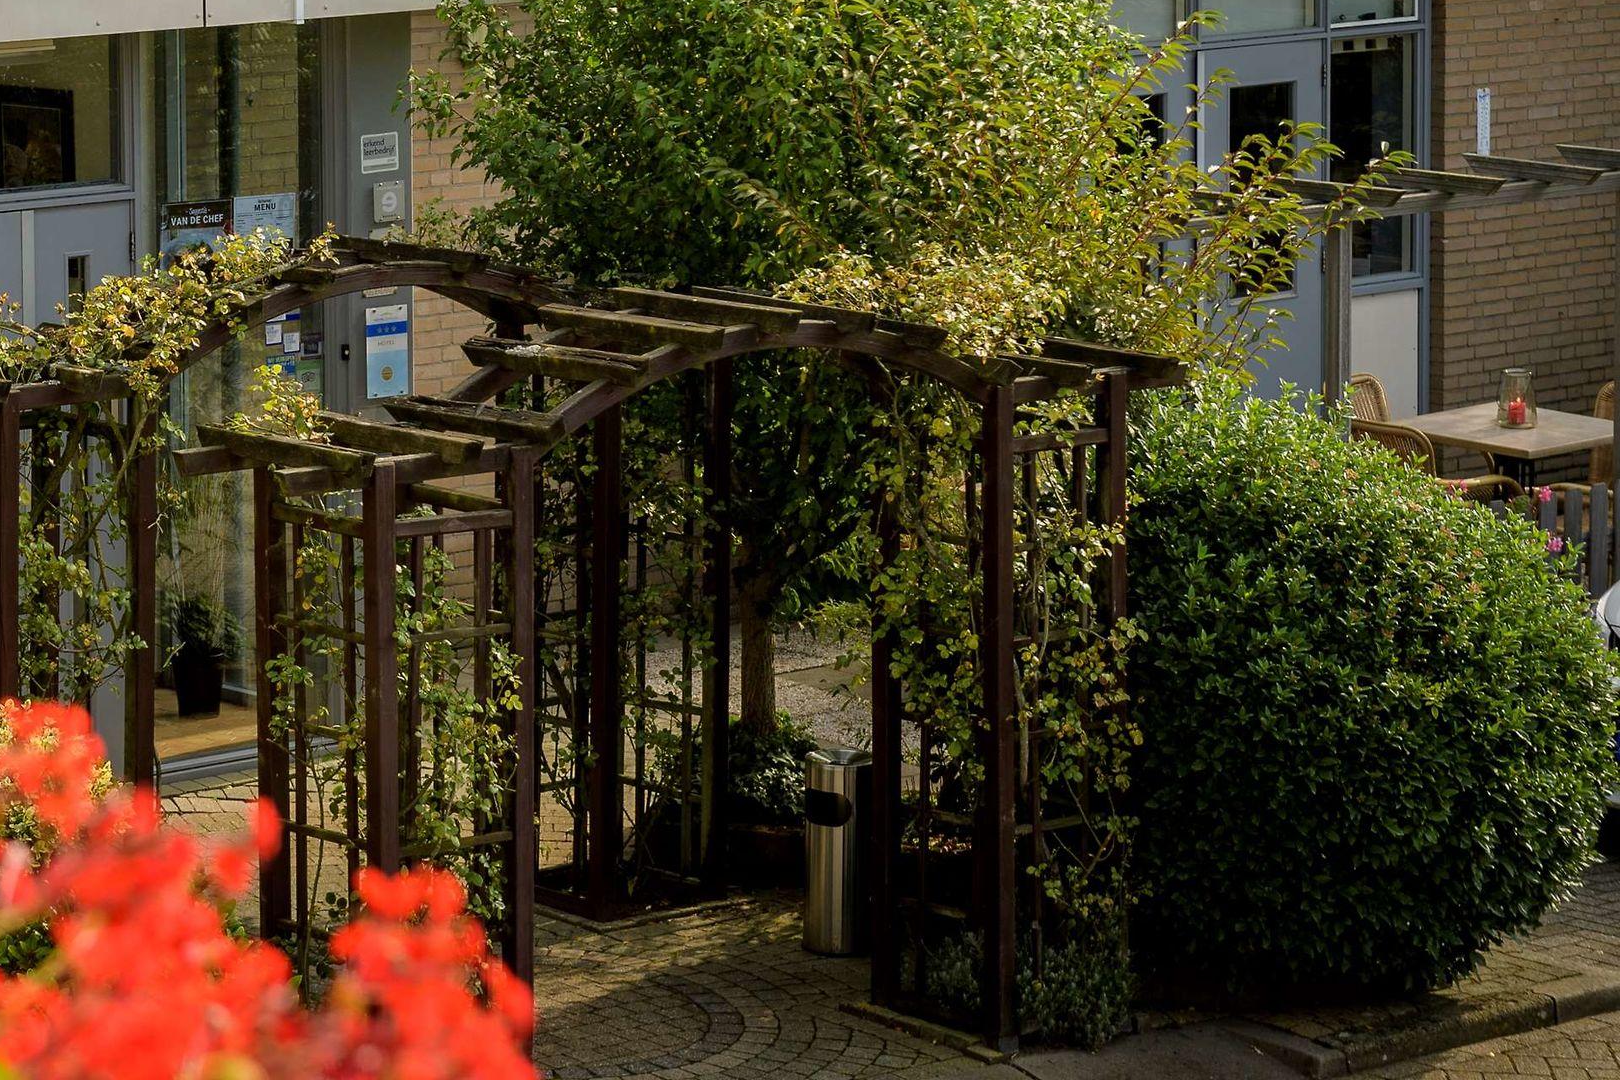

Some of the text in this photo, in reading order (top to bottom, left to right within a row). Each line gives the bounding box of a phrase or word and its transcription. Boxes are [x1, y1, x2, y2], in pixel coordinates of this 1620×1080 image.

[254, 202, 277, 212] MENU
[171, 213, 224, 226] VAN DE CHEF
